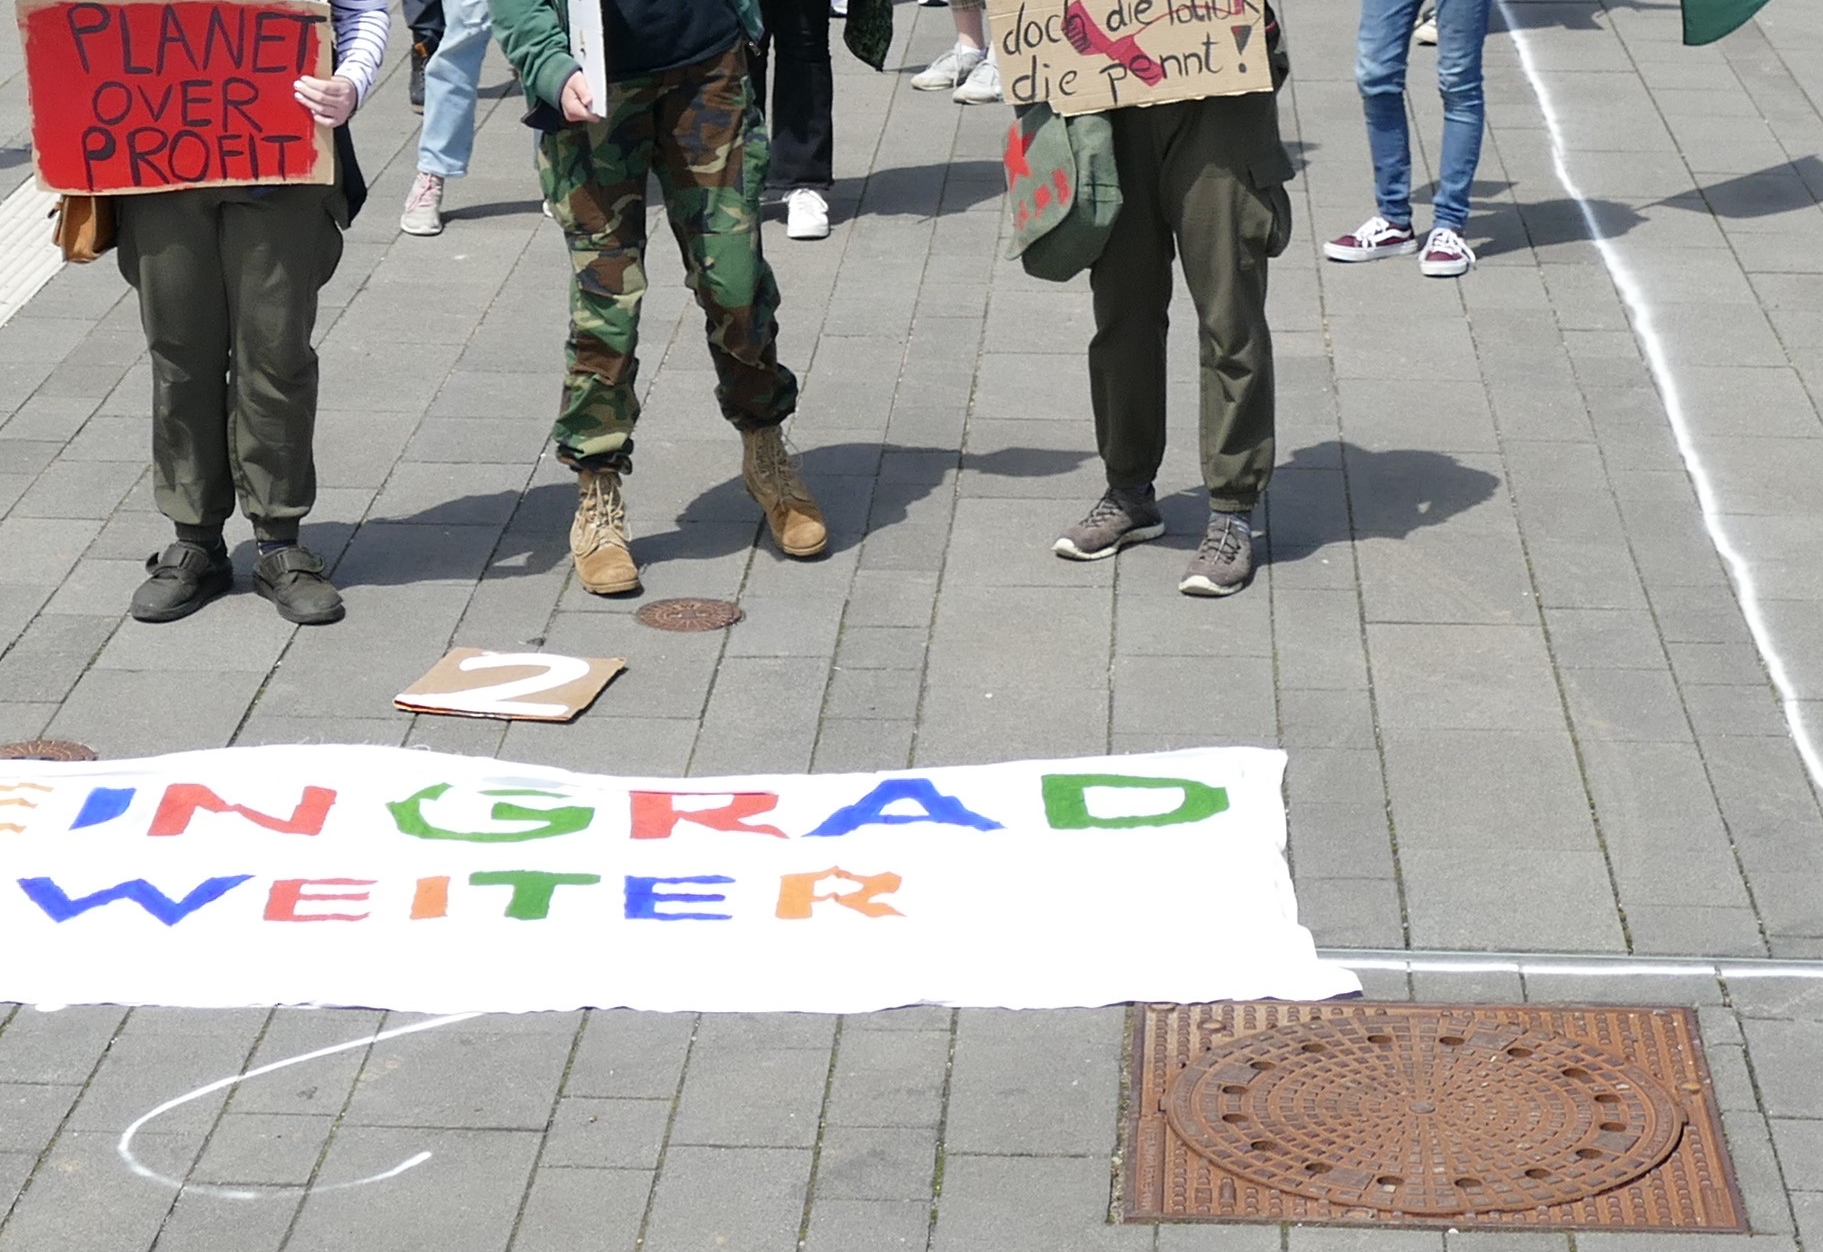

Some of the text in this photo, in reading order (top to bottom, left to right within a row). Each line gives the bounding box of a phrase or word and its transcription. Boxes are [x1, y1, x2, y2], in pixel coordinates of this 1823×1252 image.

[66, 1, 327, 76] PLANET
[1011, 24, 1254, 106] die pennt!
[91, 77, 262, 133] OVER
[81, 126, 303, 192] PROFIT
[395, 651, 591, 717] 2
[386, 774, 1231, 844] GRAD
[17, 866, 908, 927] WEITER
